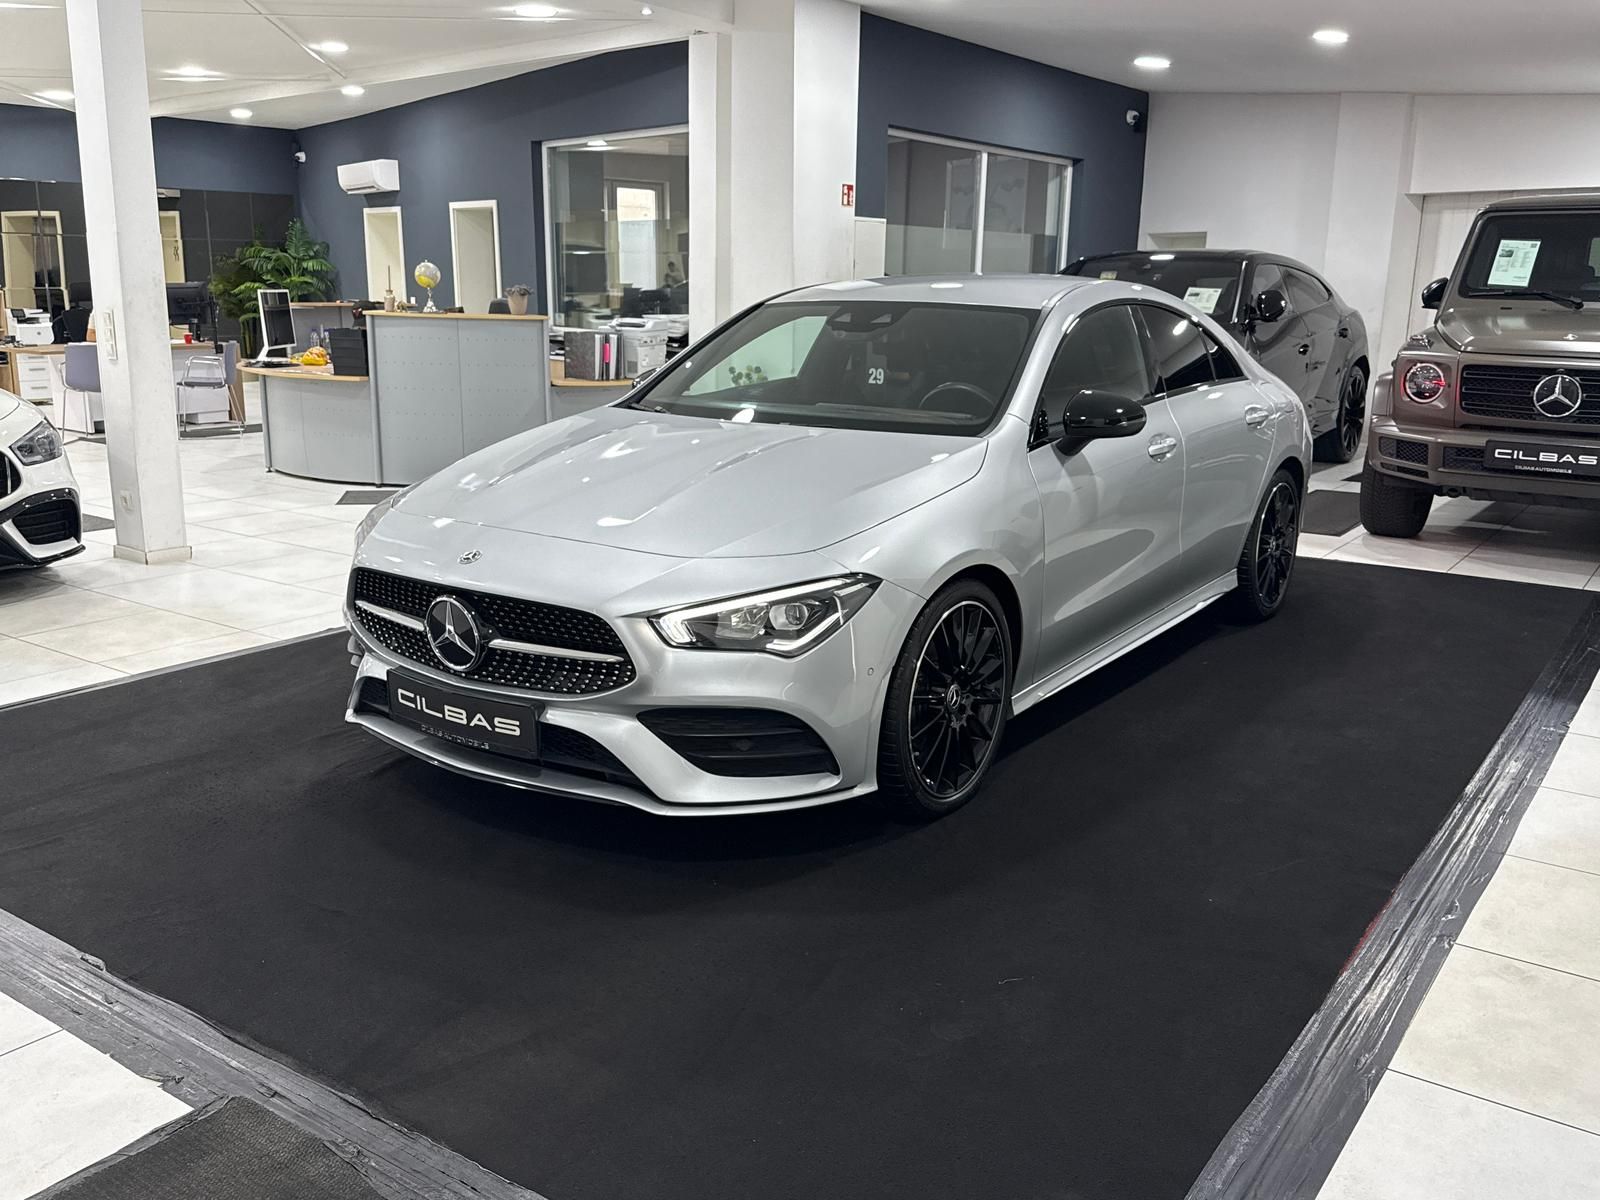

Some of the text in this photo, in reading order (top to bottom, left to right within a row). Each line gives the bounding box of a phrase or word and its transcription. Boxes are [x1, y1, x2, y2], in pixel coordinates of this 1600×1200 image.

[868, 367, 885, 385] 29
[1494, 448, 1598, 466] CILBAS
[398, 688, 521, 737] CILBAS
